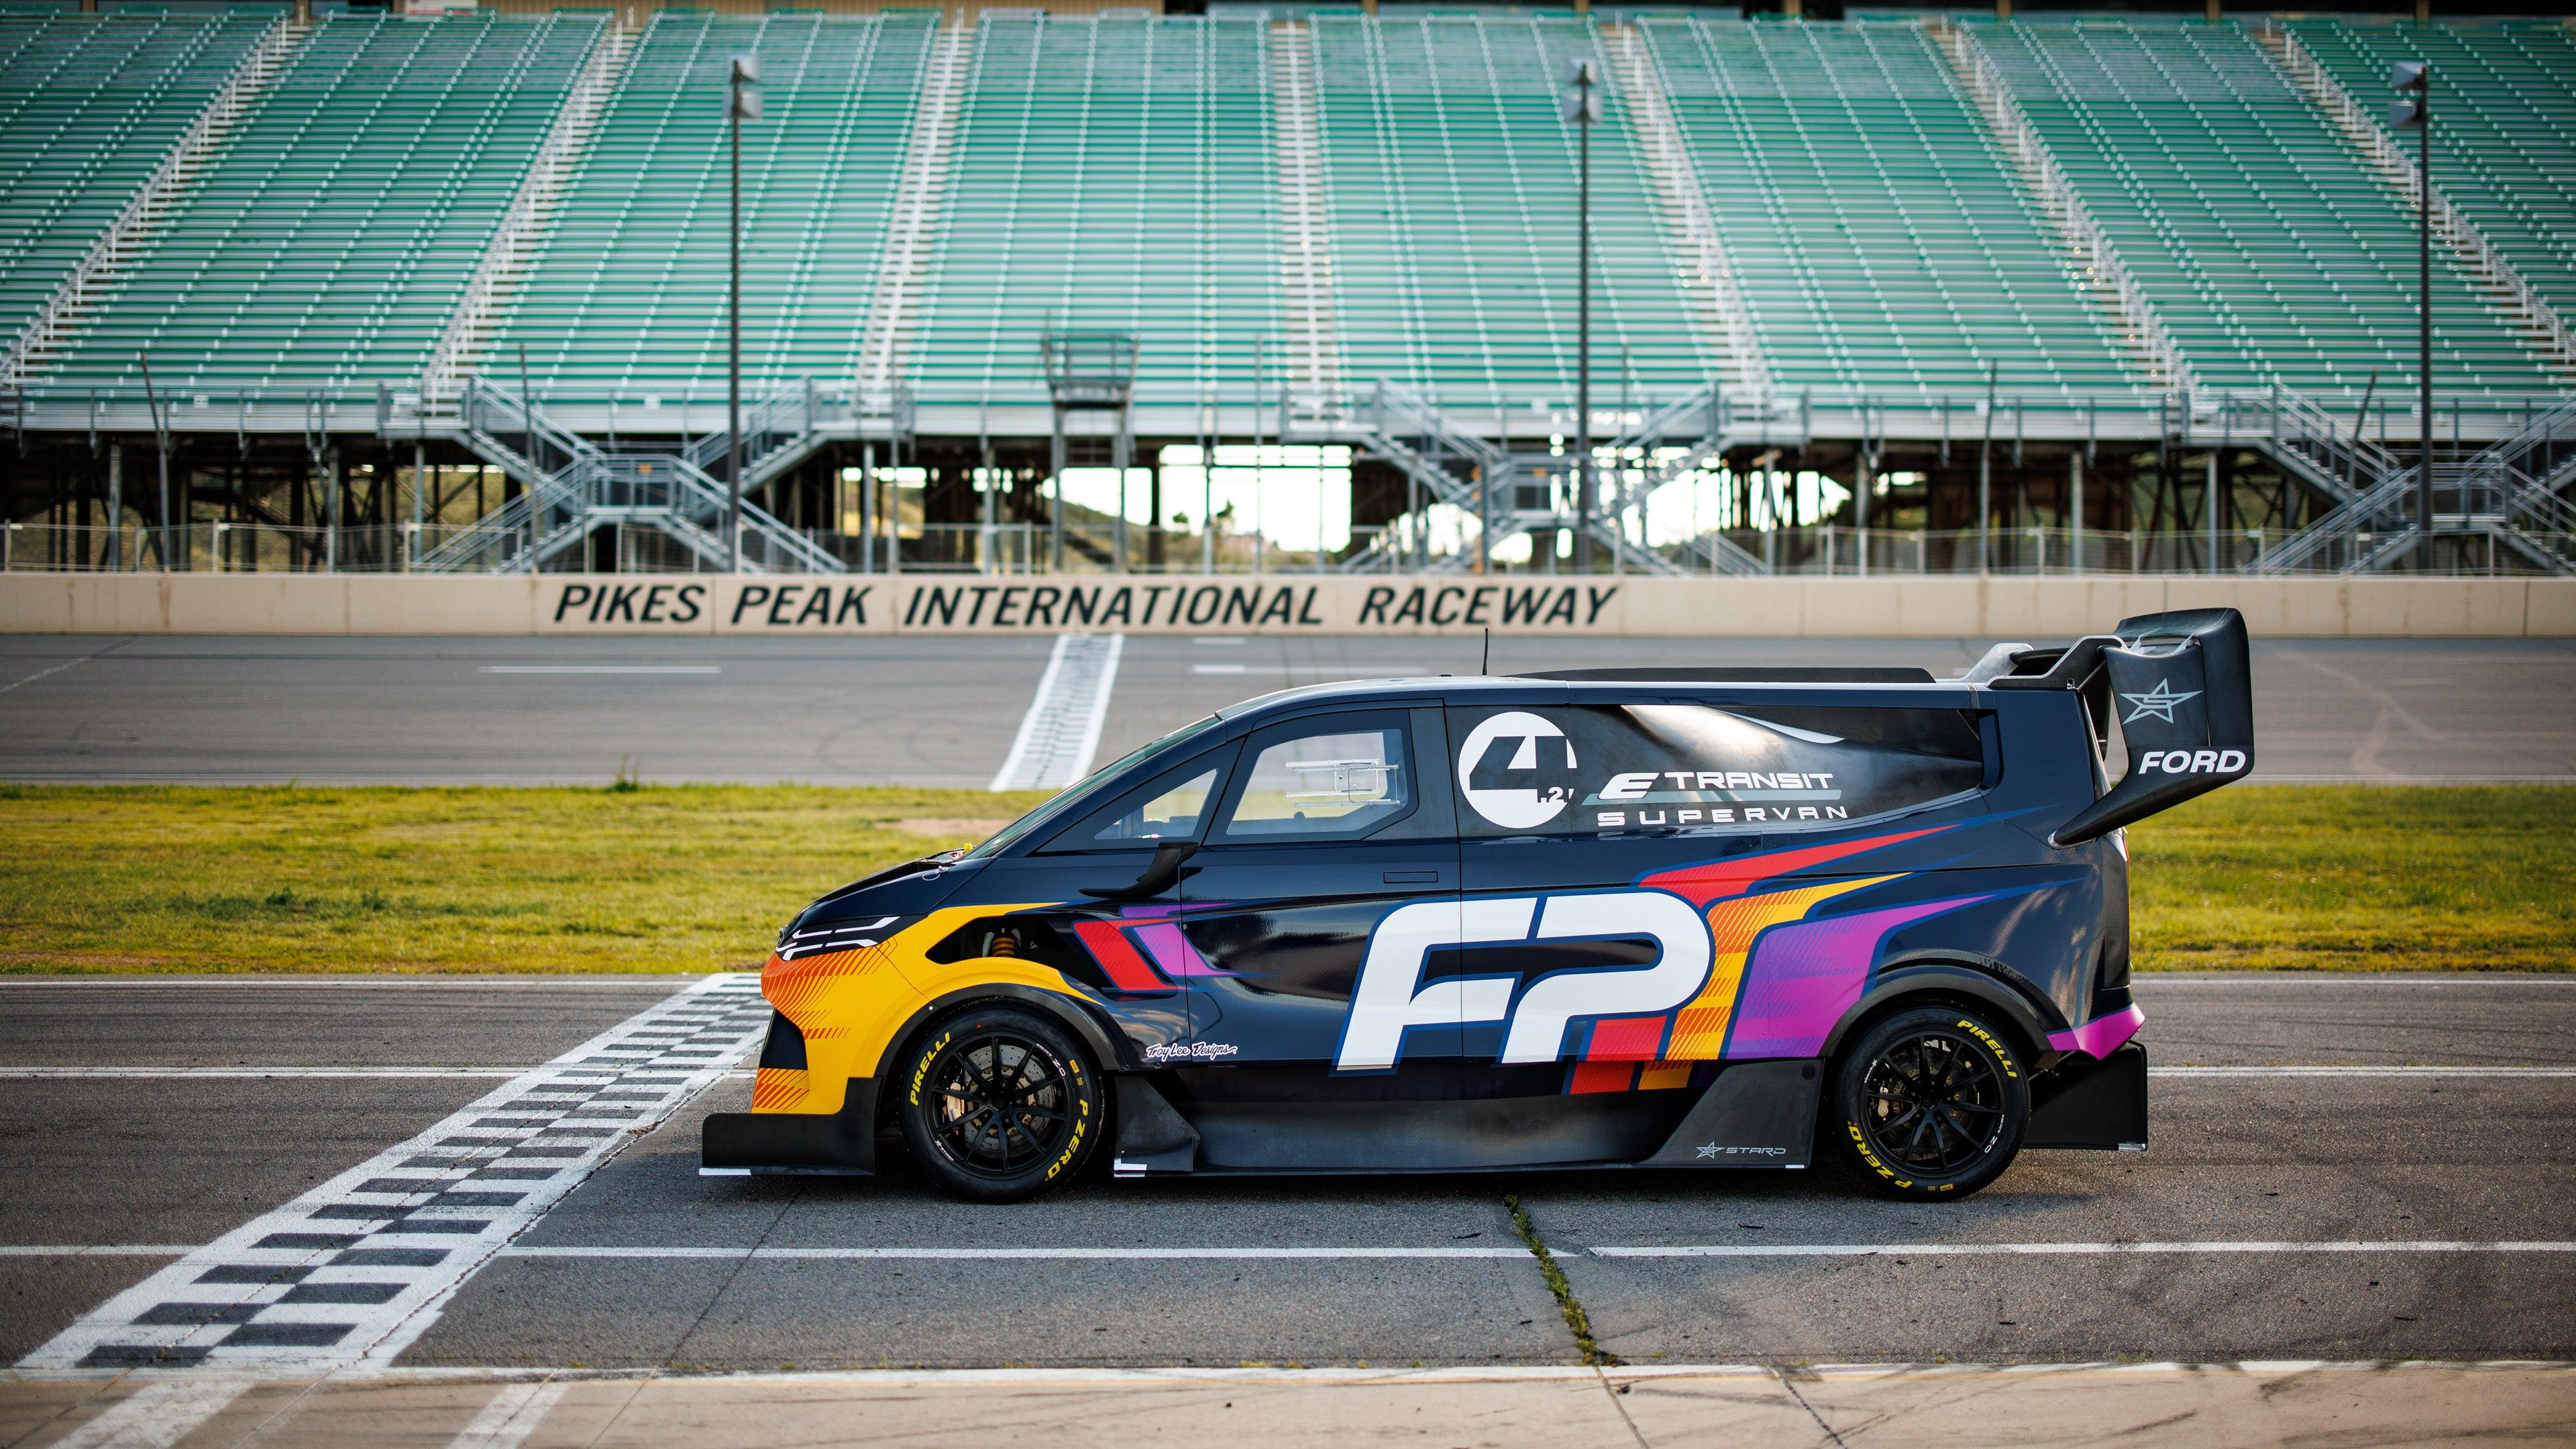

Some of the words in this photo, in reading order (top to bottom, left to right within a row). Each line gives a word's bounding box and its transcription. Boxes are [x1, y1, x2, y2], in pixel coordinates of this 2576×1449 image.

[553, 584, 706, 623] PIKES
[731, 585, 875, 625] PEAK
[904, 586, 1322, 626] INTERNATIONAL
[1358, 586, 1617, 626] RACEWAY
[2138, 750, 2246, 774] FORD
[1664, 772, 1833, 789] TRANSIT
[1598, 806, 1847, 826] SUPERVAN
[1336, 892, 1711, 1071] FP
[1191, 1042, 1238, 1061] Designs
[1957, 1020, 2018, 1078] PIRELLI
[910, 1032, 951, 1106] PIRELLI
[1079, 1099, 1088, 1116] P
[1048, 1119, 1085, 1179] ZERO
[1725, 1147, 1786, 1157] STARD
[1848, 1126, 1894, 1179] ZERO
[1894, 1180, 1913, 1188] P
